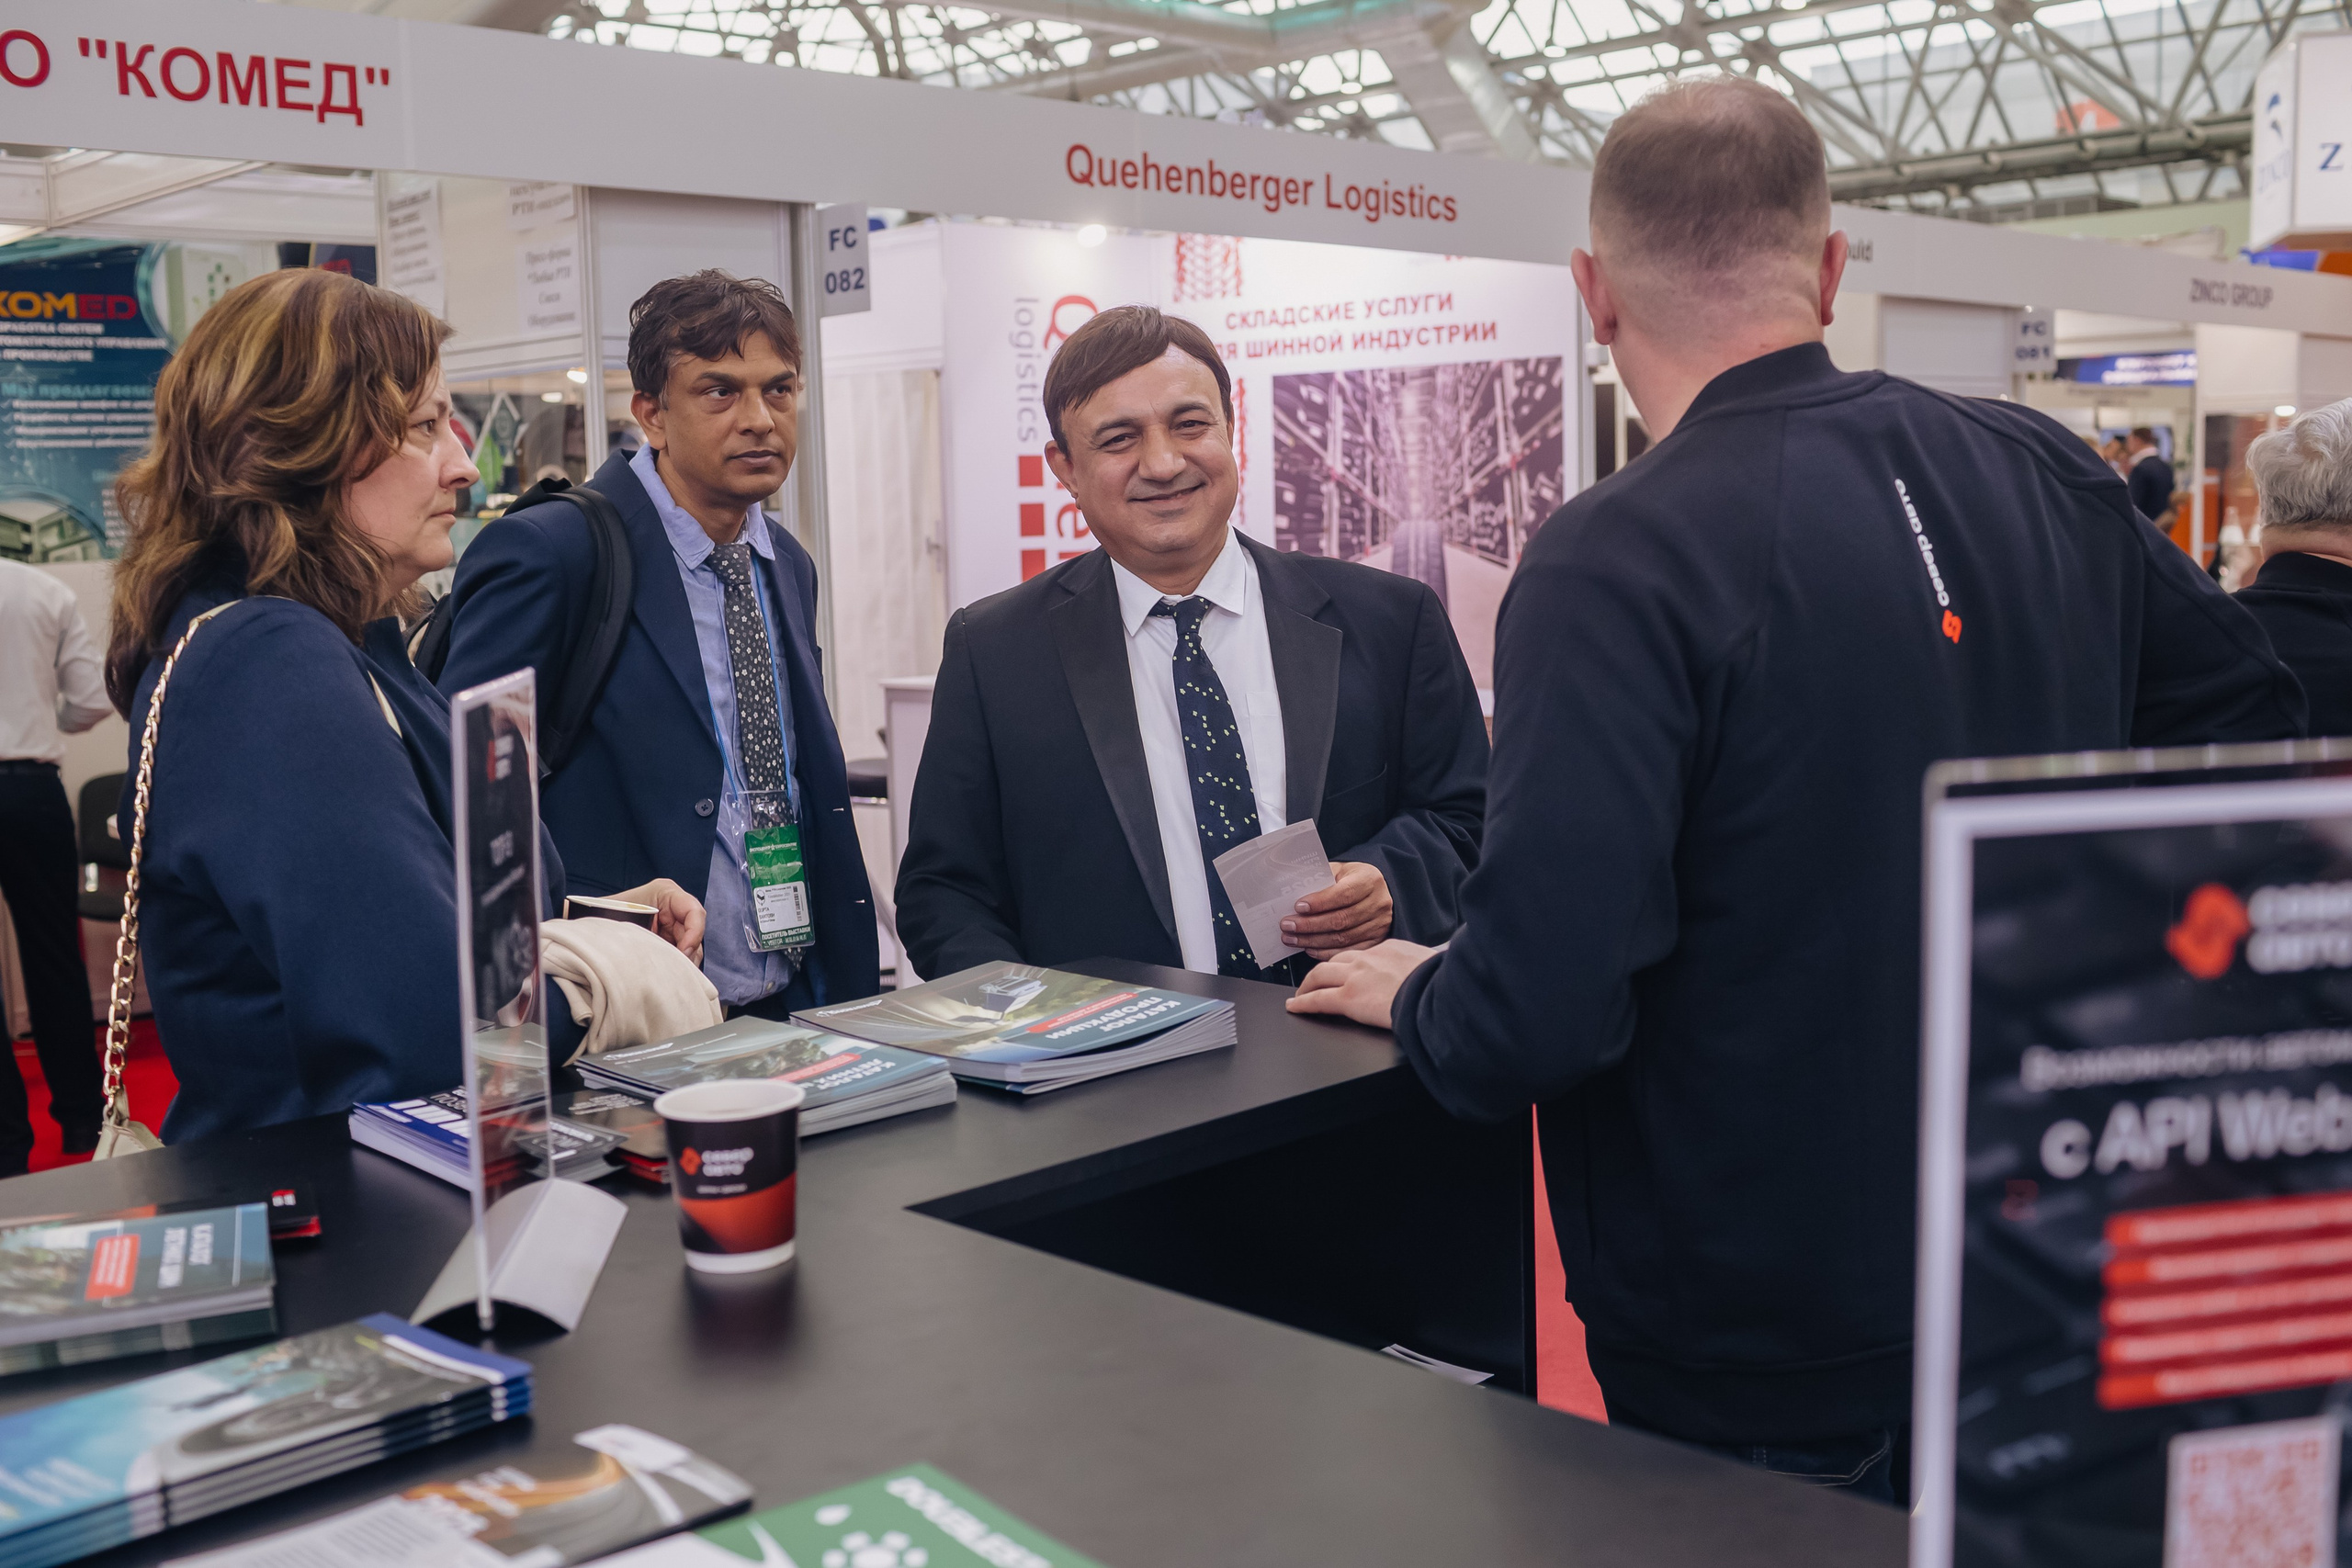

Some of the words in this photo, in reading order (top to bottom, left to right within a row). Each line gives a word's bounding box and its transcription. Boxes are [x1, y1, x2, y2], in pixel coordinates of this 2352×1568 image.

[77, 37, 390, 127] "КОМЕД"
[1066, 143, 1314, 213] Quehenberger
[1326, 172, 1458, 223] Logistics
[829, 226, 857, 251] FC
[824, 267, 865, 294] 082
[1226, 300, 1356, 331] СКЛАДСКИЕ
[1364, 292, 1453, 319] УСЛУГИ
[1216, 343, 1238, 360] ЛЯ
[1246, 333, 1342, 358] ШИННОЙ
[1352, 321, 1498, 351] ИНДУСТРИИ
[1009, 296, 1041, 444] logistics
[2095, 1098, 2212, 1174] API
